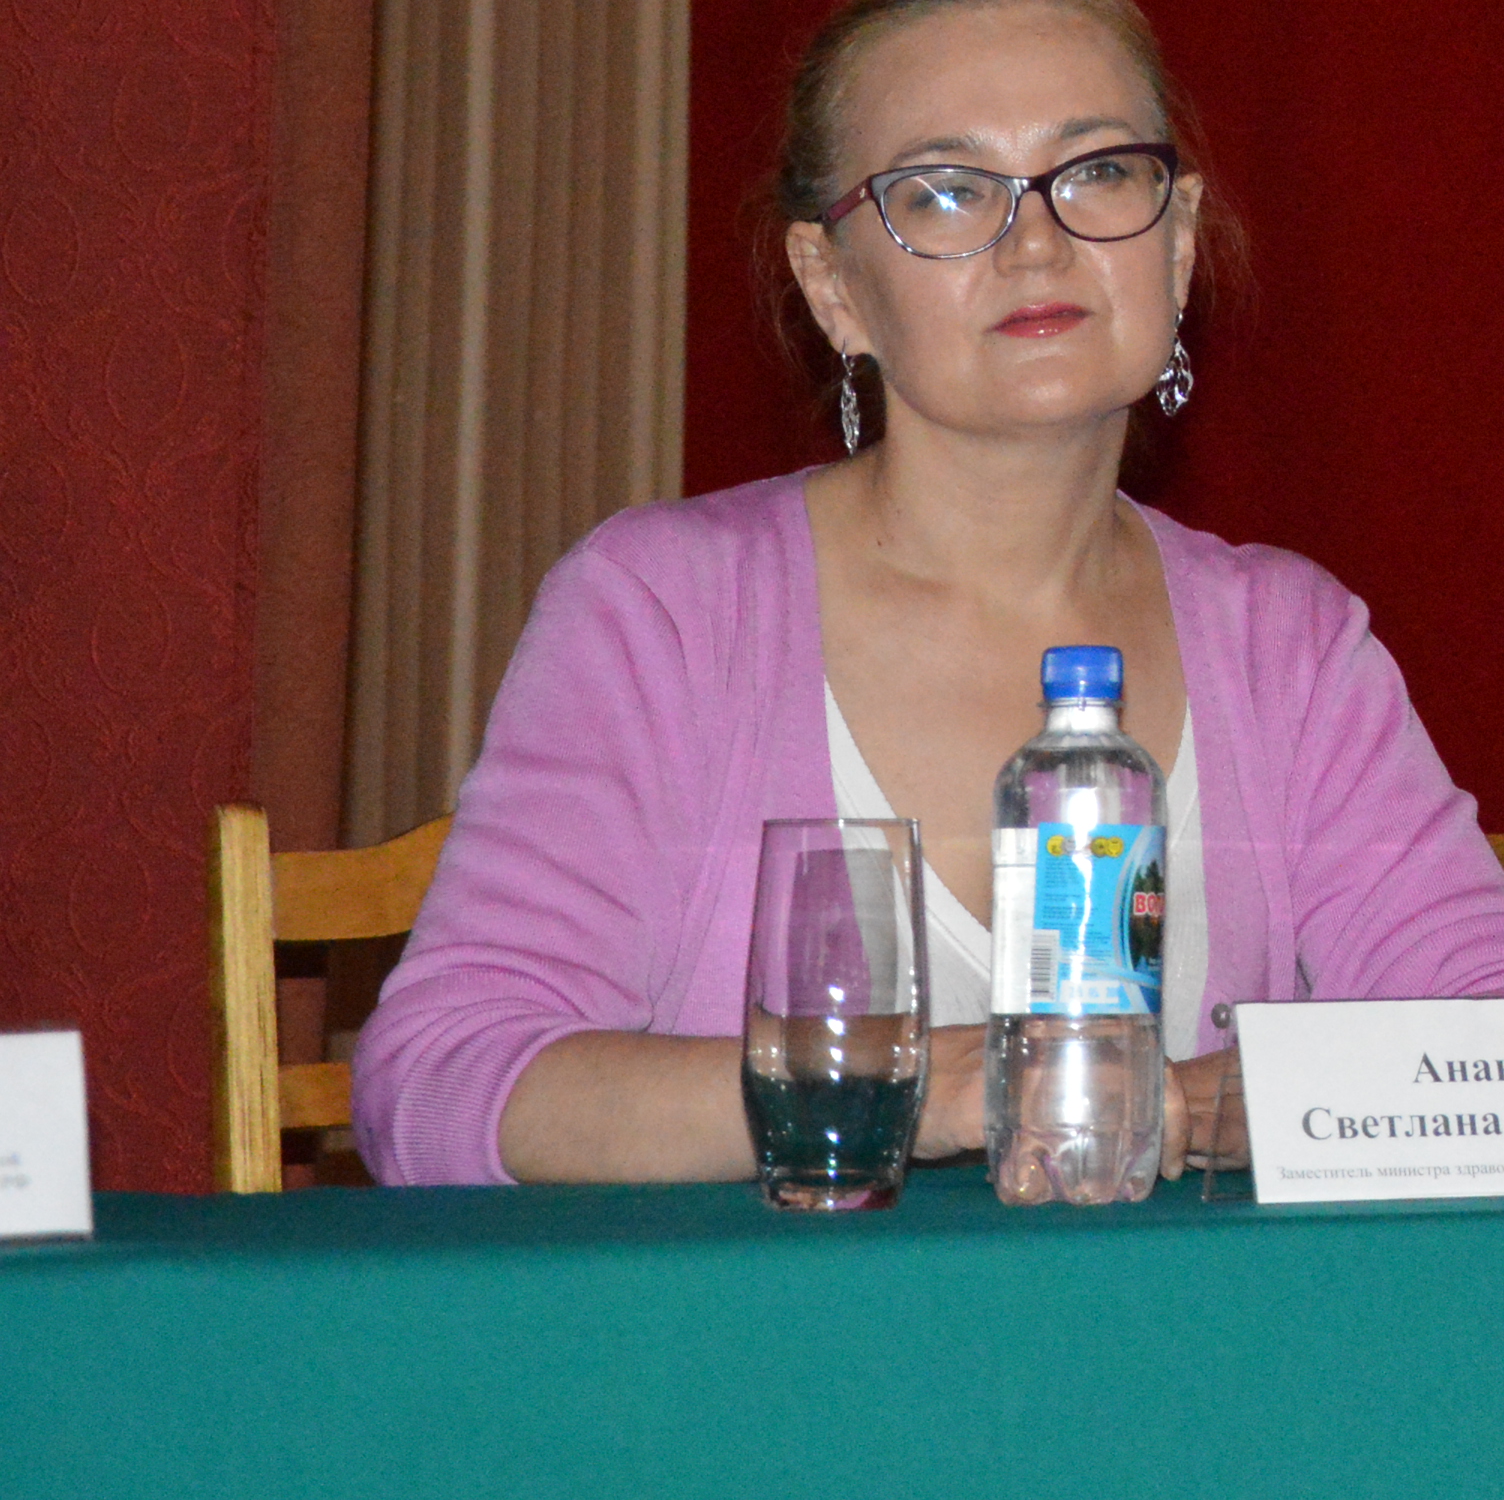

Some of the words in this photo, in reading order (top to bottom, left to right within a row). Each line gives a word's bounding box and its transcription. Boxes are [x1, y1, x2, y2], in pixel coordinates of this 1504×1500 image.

[1301, 1107, 1503, 1141] Светлана
[1276, 1166, 1373, 1180] Заместитель
[1376, 1165, 1451, 1180] министра
